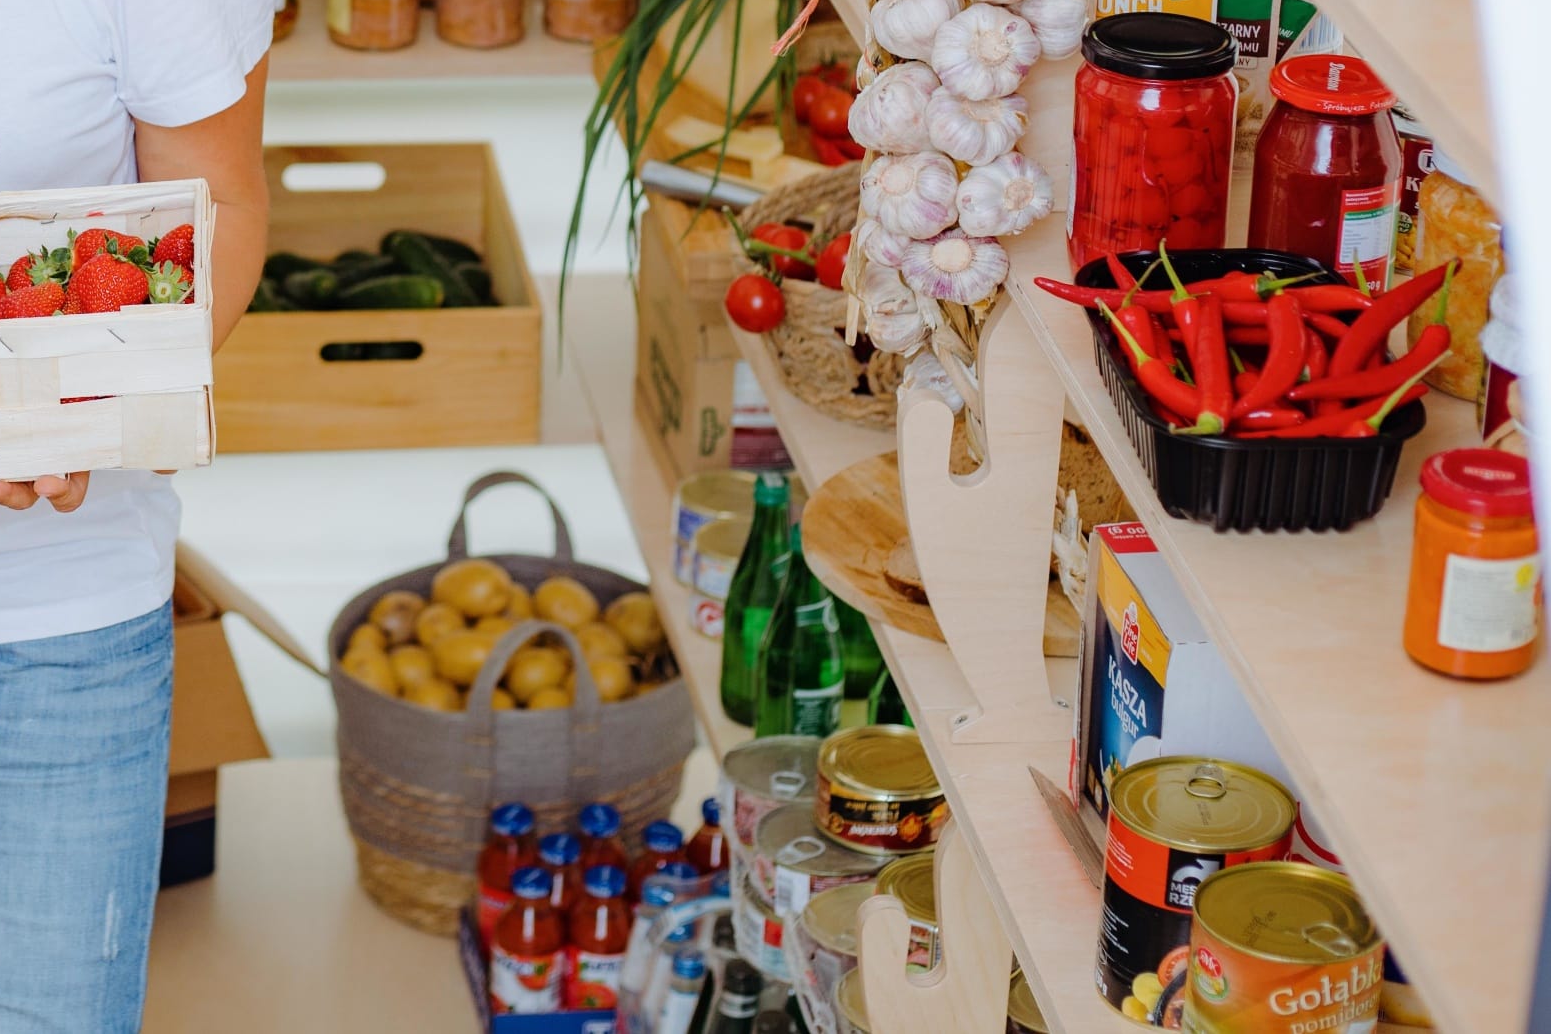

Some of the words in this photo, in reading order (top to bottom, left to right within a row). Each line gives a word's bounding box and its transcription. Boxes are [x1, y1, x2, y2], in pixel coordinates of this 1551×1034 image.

[1218, 22, 1262, 39] ZARNY
[1237, 42, 1260, 53] AMU
[1124, 619, 1138, 642] Fine
[1123, 633, 1136, 657] Life
[1108, 654, 1147, 729] KASZA
[1111, 686, 1139, 739] bulgur
